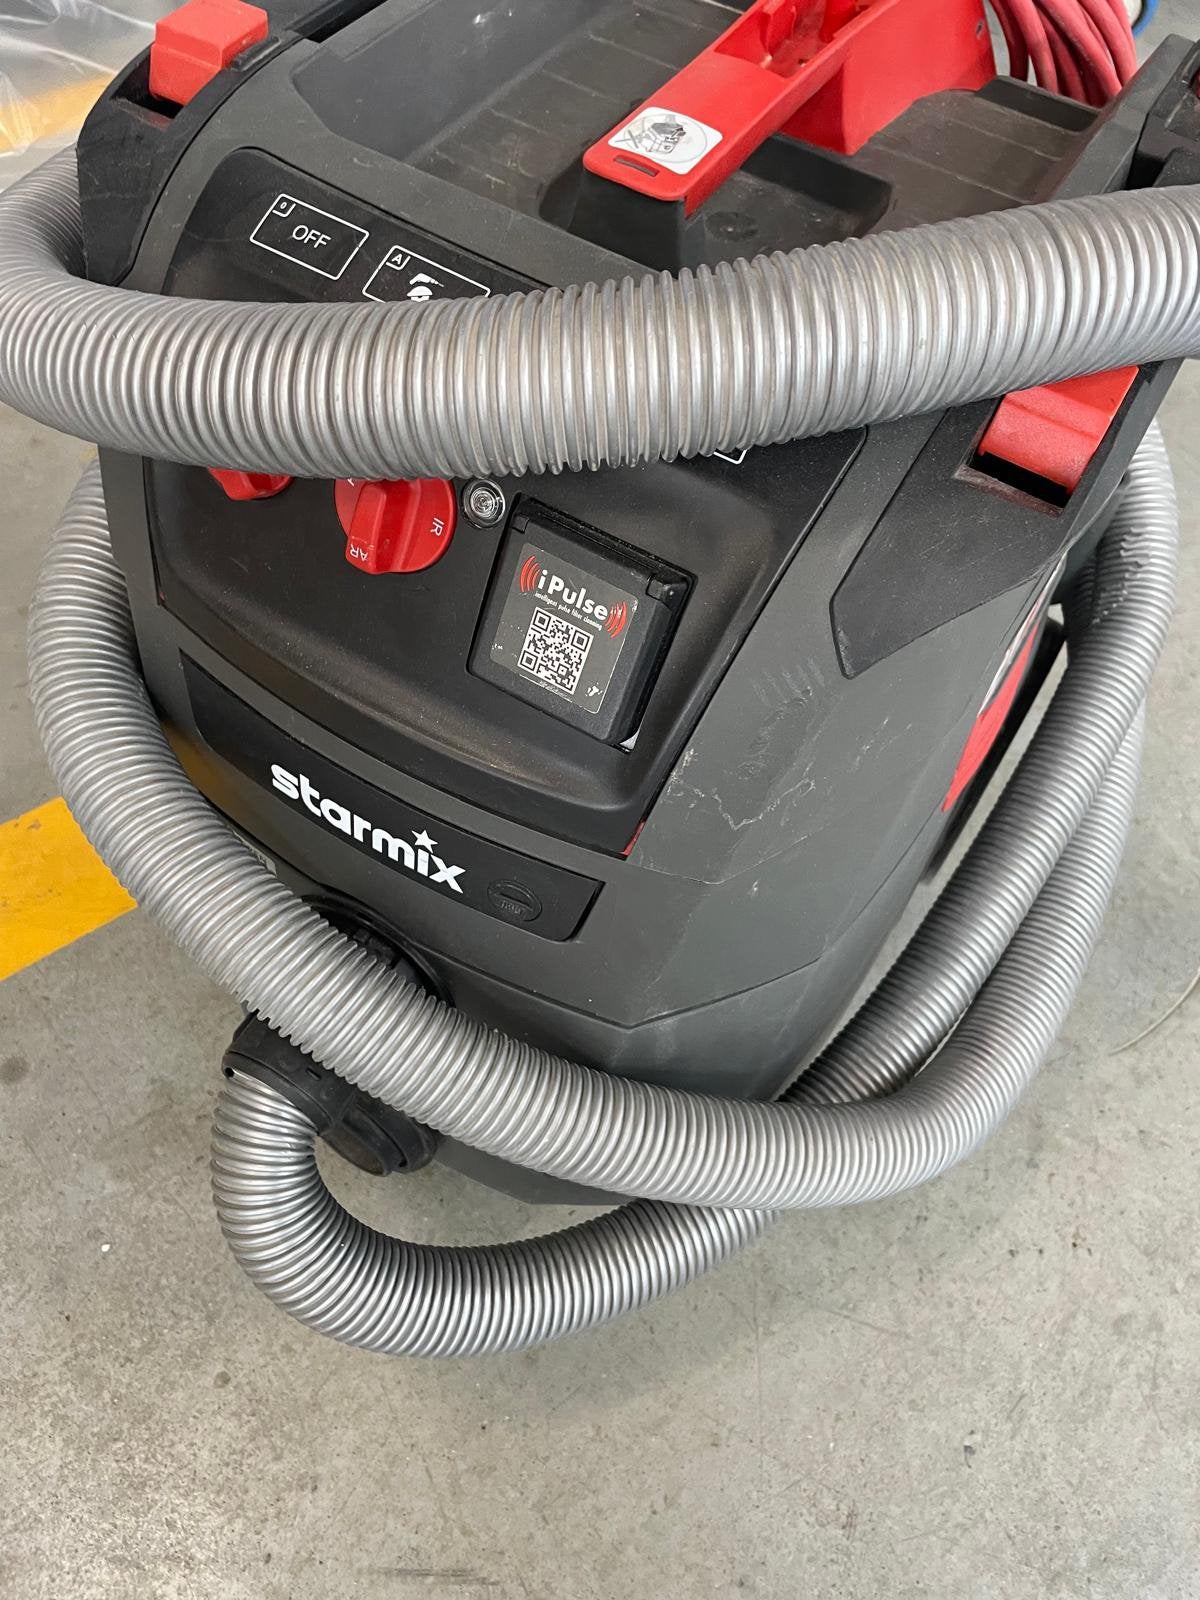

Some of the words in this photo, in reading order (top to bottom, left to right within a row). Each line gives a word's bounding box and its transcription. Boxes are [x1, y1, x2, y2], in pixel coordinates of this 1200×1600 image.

[292, 224, 331, 249] OFF
[391, 253, 402, 265] A
[430, 517, 445, 537] IR
[349, 543, 368, 562] AR
[270, 763, 467, 894] starmix
